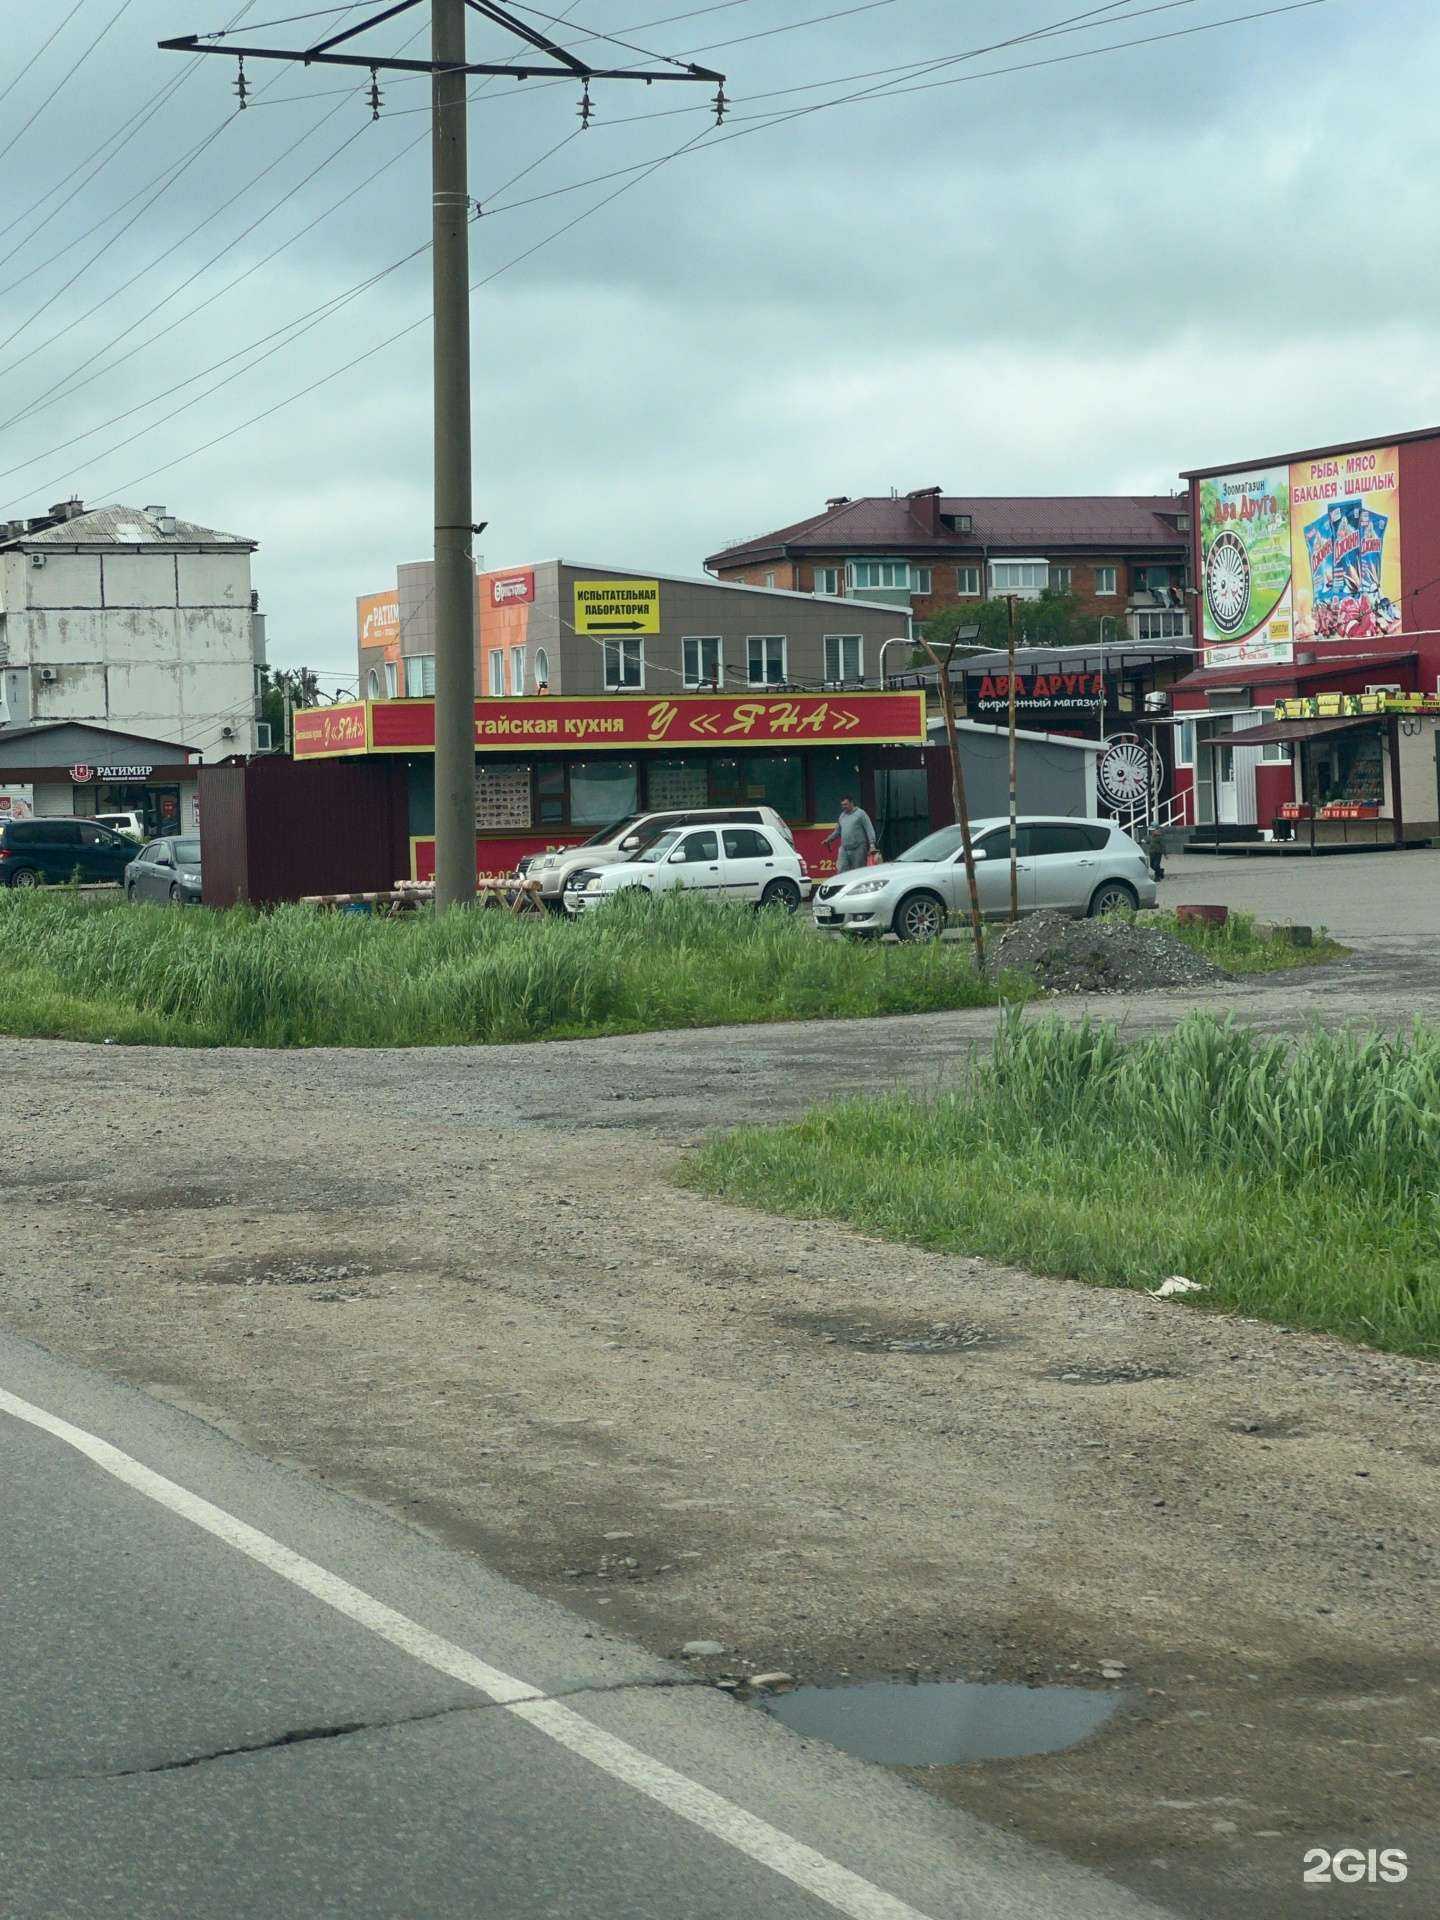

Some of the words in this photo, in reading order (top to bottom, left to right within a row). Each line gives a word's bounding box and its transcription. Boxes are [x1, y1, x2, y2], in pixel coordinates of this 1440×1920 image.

[1310, 461, 1339, 480] РЫБА
[1346, 454, 1376, 473] МЯСО
[1222, 481, 1265, 496] Зоомагазин
[1293, 482, 1338, 503] БАКАЛЕЯ
[1344, 473, 1395, 495] ШАШЛЫК
[577, 589, 656, 601] ИСПЫТАТЕЛЬНАЯ
[585, 604, 649, 615] ЛАБОРАТОРИЯ
[979, 675, 1026, 698] ДВА
[1033, 674, 1107, 697] ДРУГА
[978, 698, 1051, 712] фирмнный
[564, 718, 624, 738] кухня
[647, 701, 679, 741] У
[97, 766, 153, 776] РАТИМИР
